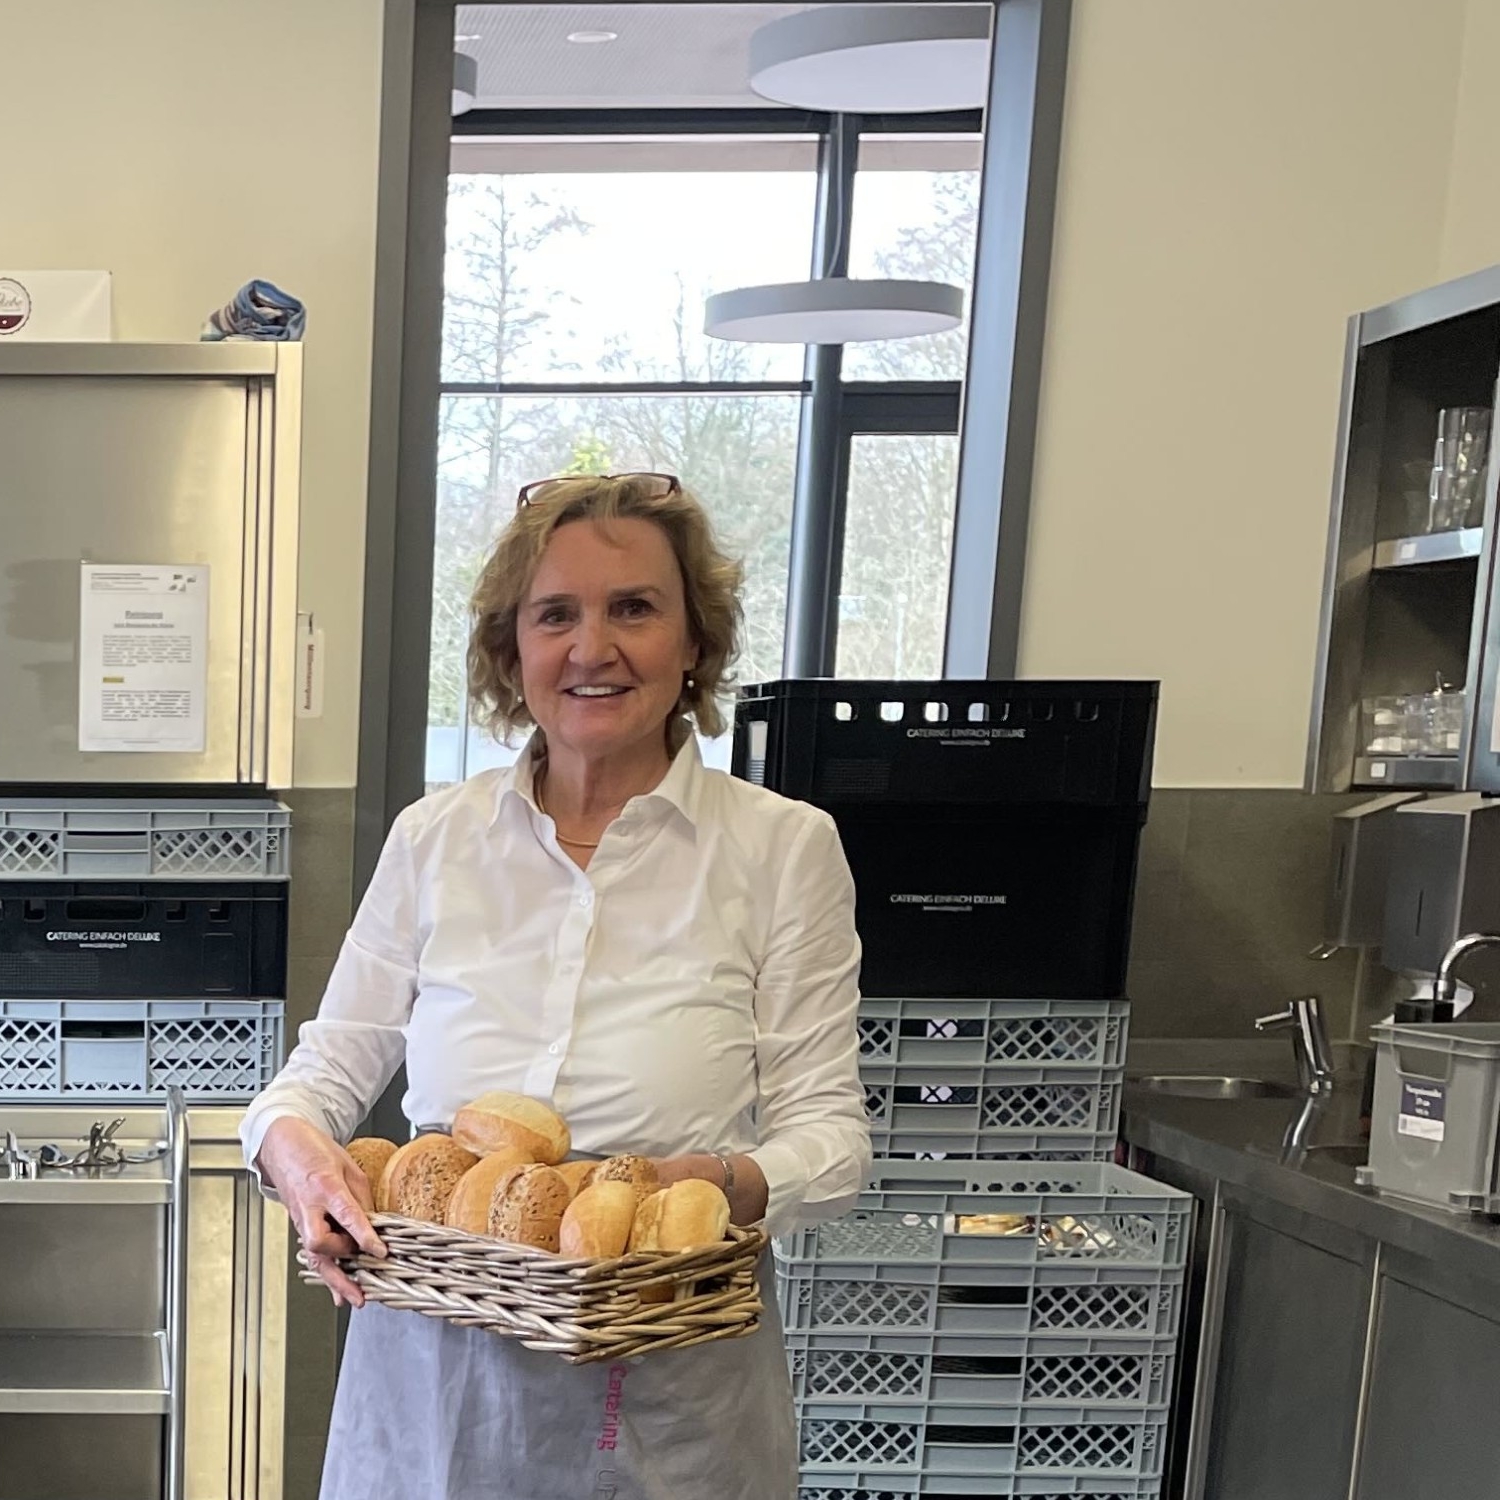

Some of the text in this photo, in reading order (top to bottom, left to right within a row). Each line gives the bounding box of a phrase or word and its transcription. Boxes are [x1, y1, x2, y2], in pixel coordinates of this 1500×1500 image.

[907, 728, 950, 737] CATERING
[890, 894, 933, 903] CATERING
[46, 931, 161, 942] CATERING EINFACH DELUXE
[596, 1364, 628, 1451] Catering
